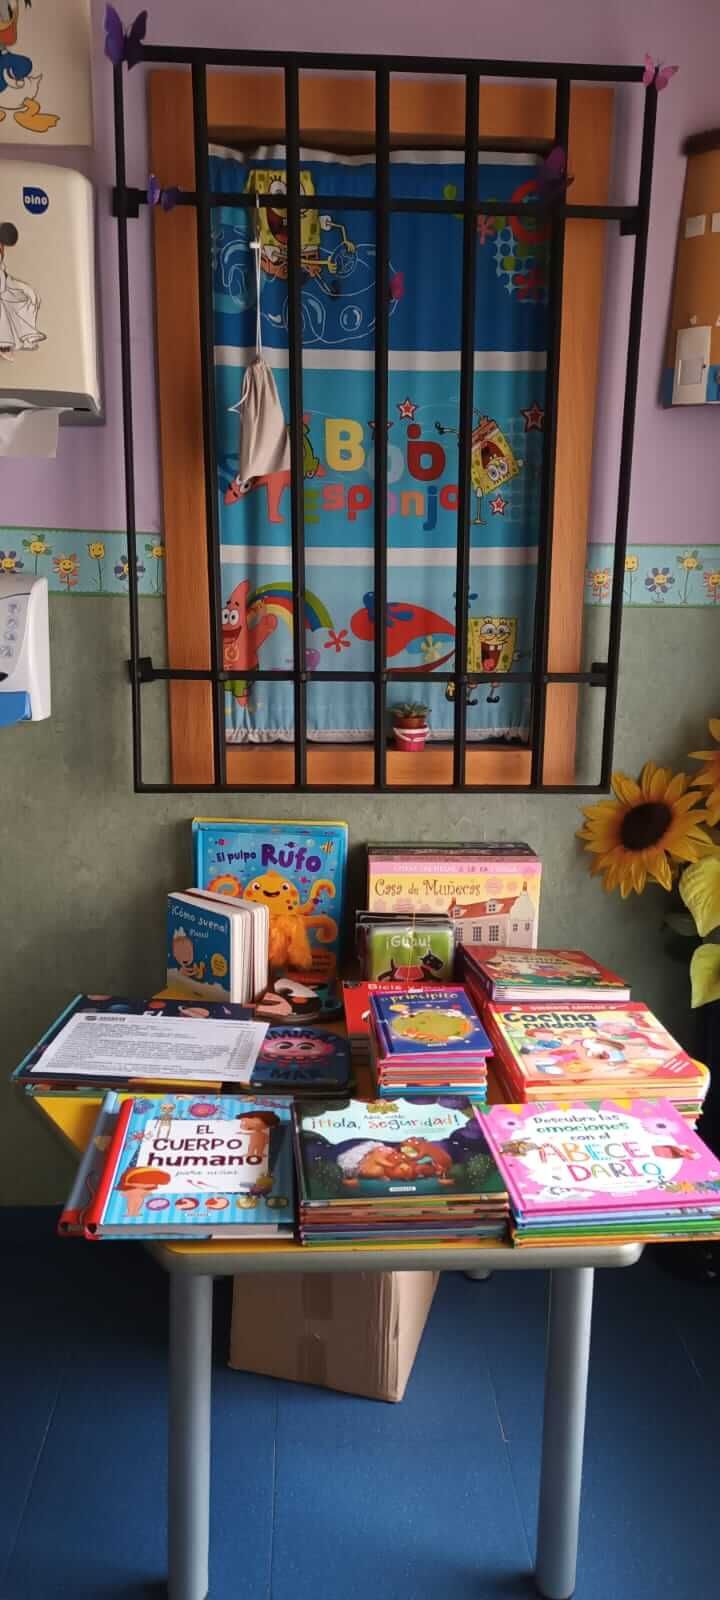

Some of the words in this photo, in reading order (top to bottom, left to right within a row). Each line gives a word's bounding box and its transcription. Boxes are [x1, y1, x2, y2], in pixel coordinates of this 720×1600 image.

[324, 418, 446, 482] Bob
[216, 852, 226, 862] El
[227, 850, 257, 864] pulpo
[261, 843, 322, 873] Rufo
[375, 879, 402, 897] Casa
[423, 879, 481, 897] Muñecas
[503, 1011, 597, 1031] Cocina
[196, 1124, 214, 1135] EL
[311, 1116, 362, 1130] ¡Hola,
[368, 1114, 461, 1131] seguridad!
[535, 1121, 630, 1134] emociones
[152, 1138, 243, 1151] CUERPO
[570, 1133, 599, 1142] con
[601, 1131, 612, 1140] el
[147, 1152, 263, 1167] humano
[537, 1141, 650, 1164] ABECE
